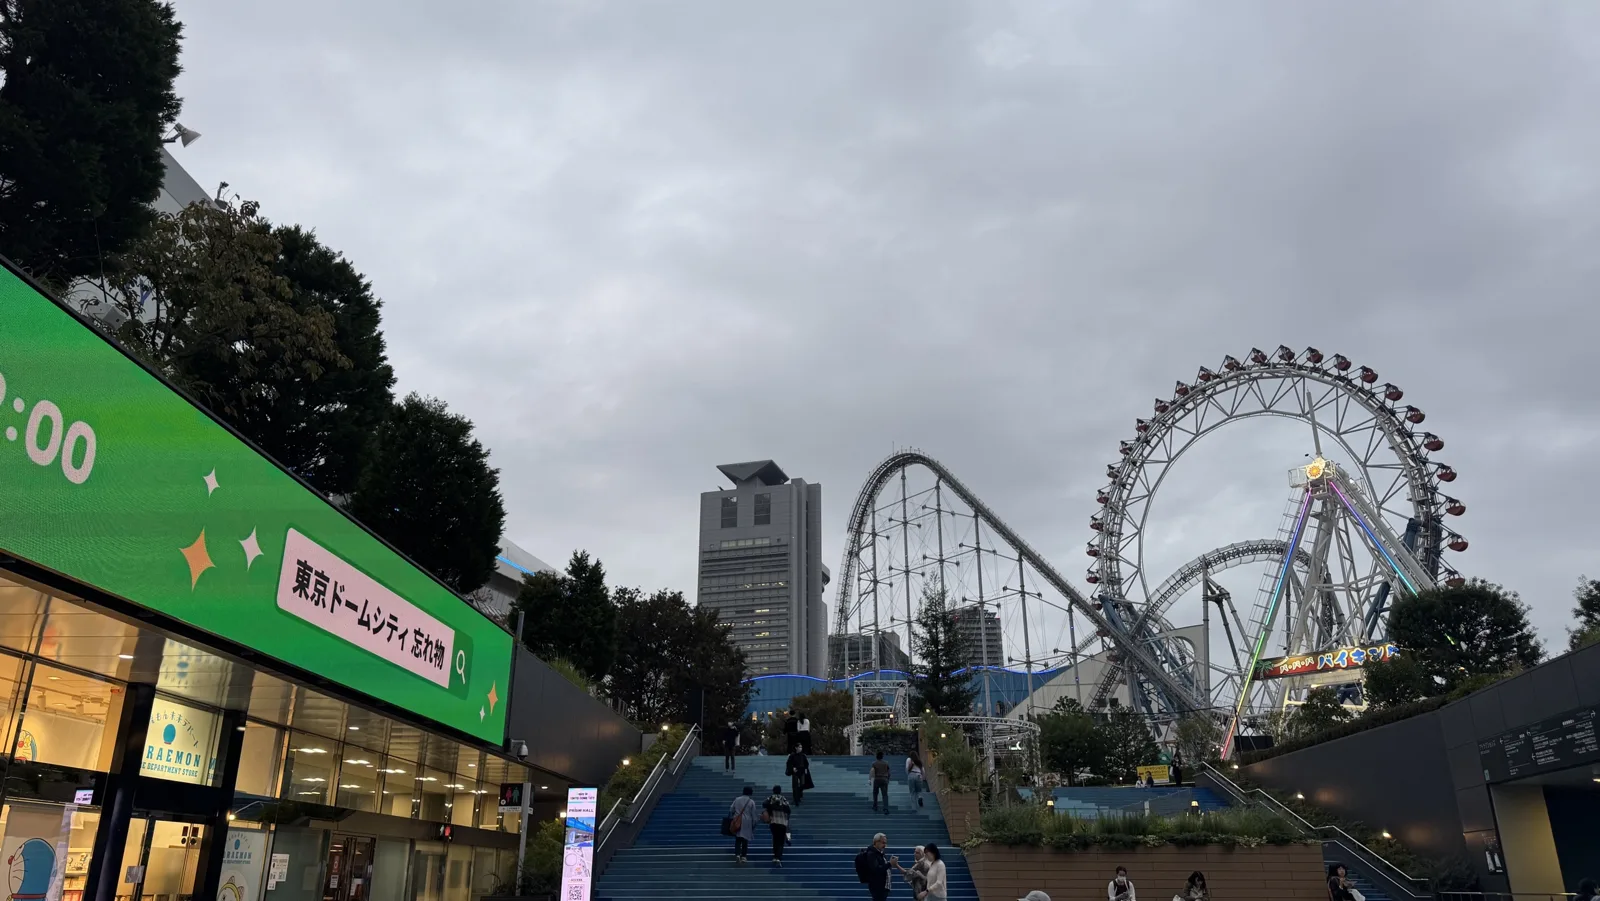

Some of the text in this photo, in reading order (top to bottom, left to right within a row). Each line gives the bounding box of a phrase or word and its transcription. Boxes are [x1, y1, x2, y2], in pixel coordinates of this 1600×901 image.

[0, 373, 97, 484] :00
[292, 558, 446, 670] 東京ドームシティ 忘れ物
[147, 763, 182, 775] DEPARTMENT
[182, 769, 198, 777] STORE
